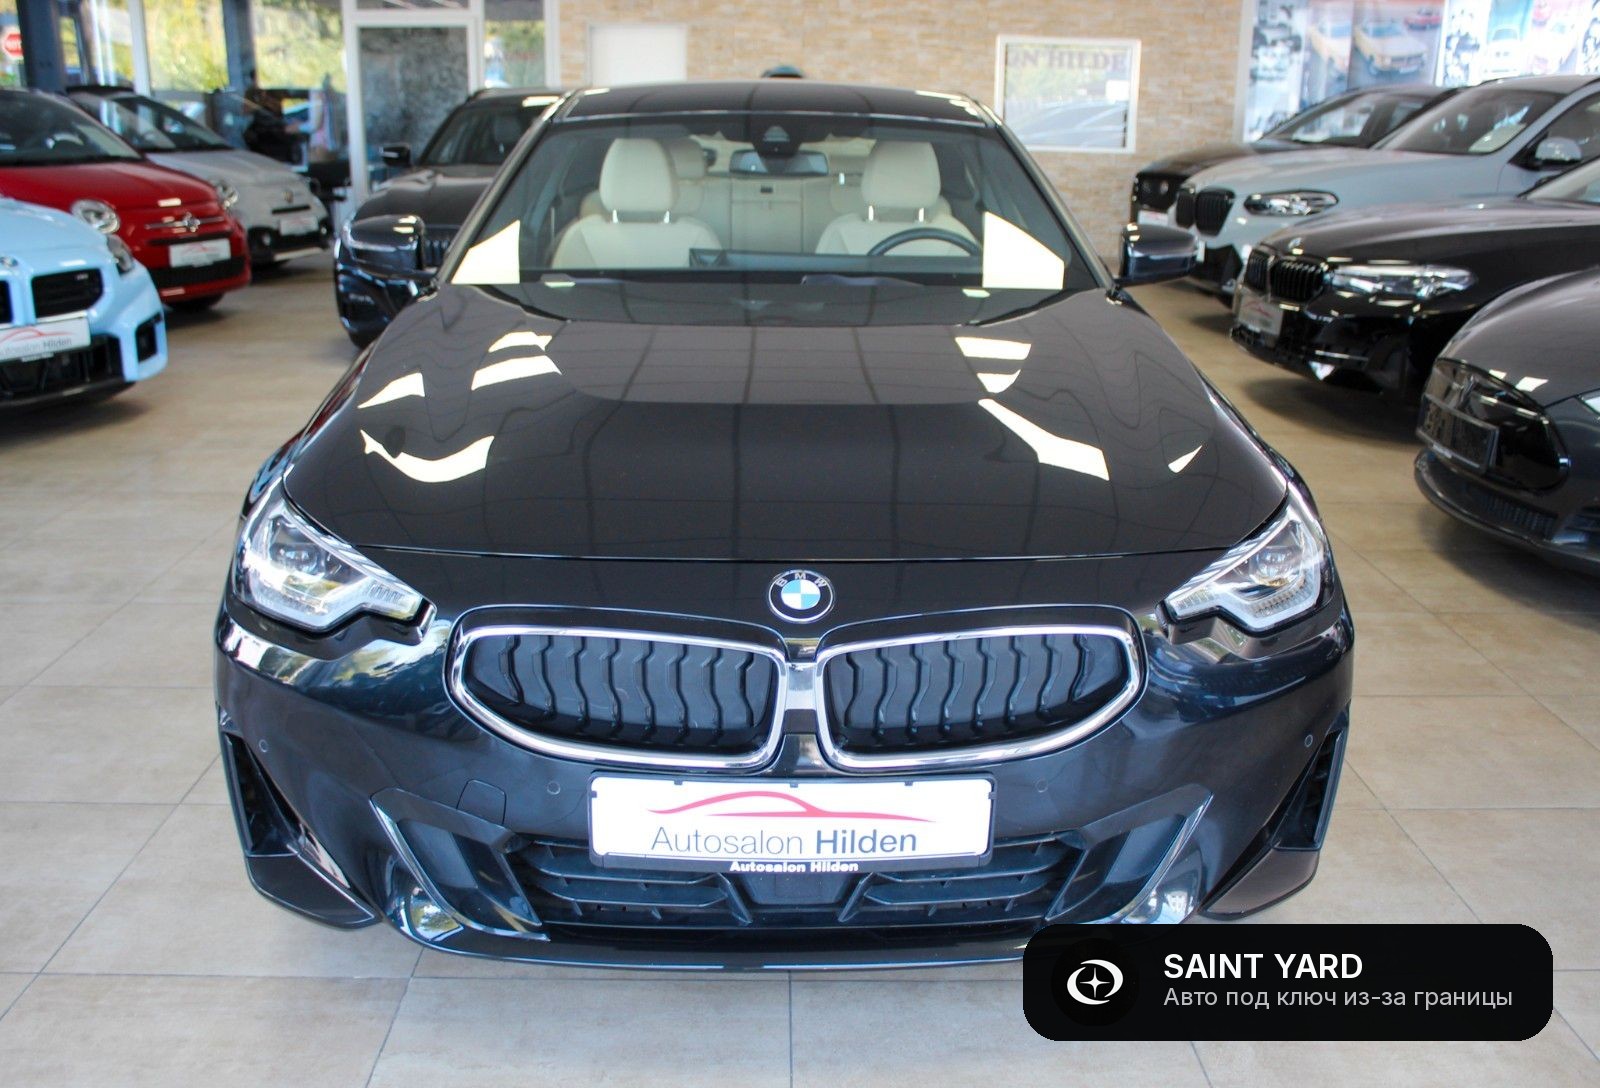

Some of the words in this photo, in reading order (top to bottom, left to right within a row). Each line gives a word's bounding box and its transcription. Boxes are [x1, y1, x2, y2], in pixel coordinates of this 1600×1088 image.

[775, 571, 827, 588] BMW
[650, 826, 803, 855] Autosalon
[815, 828, 917, 855] Hilden
[729, 860, 806, 874] Autosalon
[810, 861, 859, 874] Hilden
